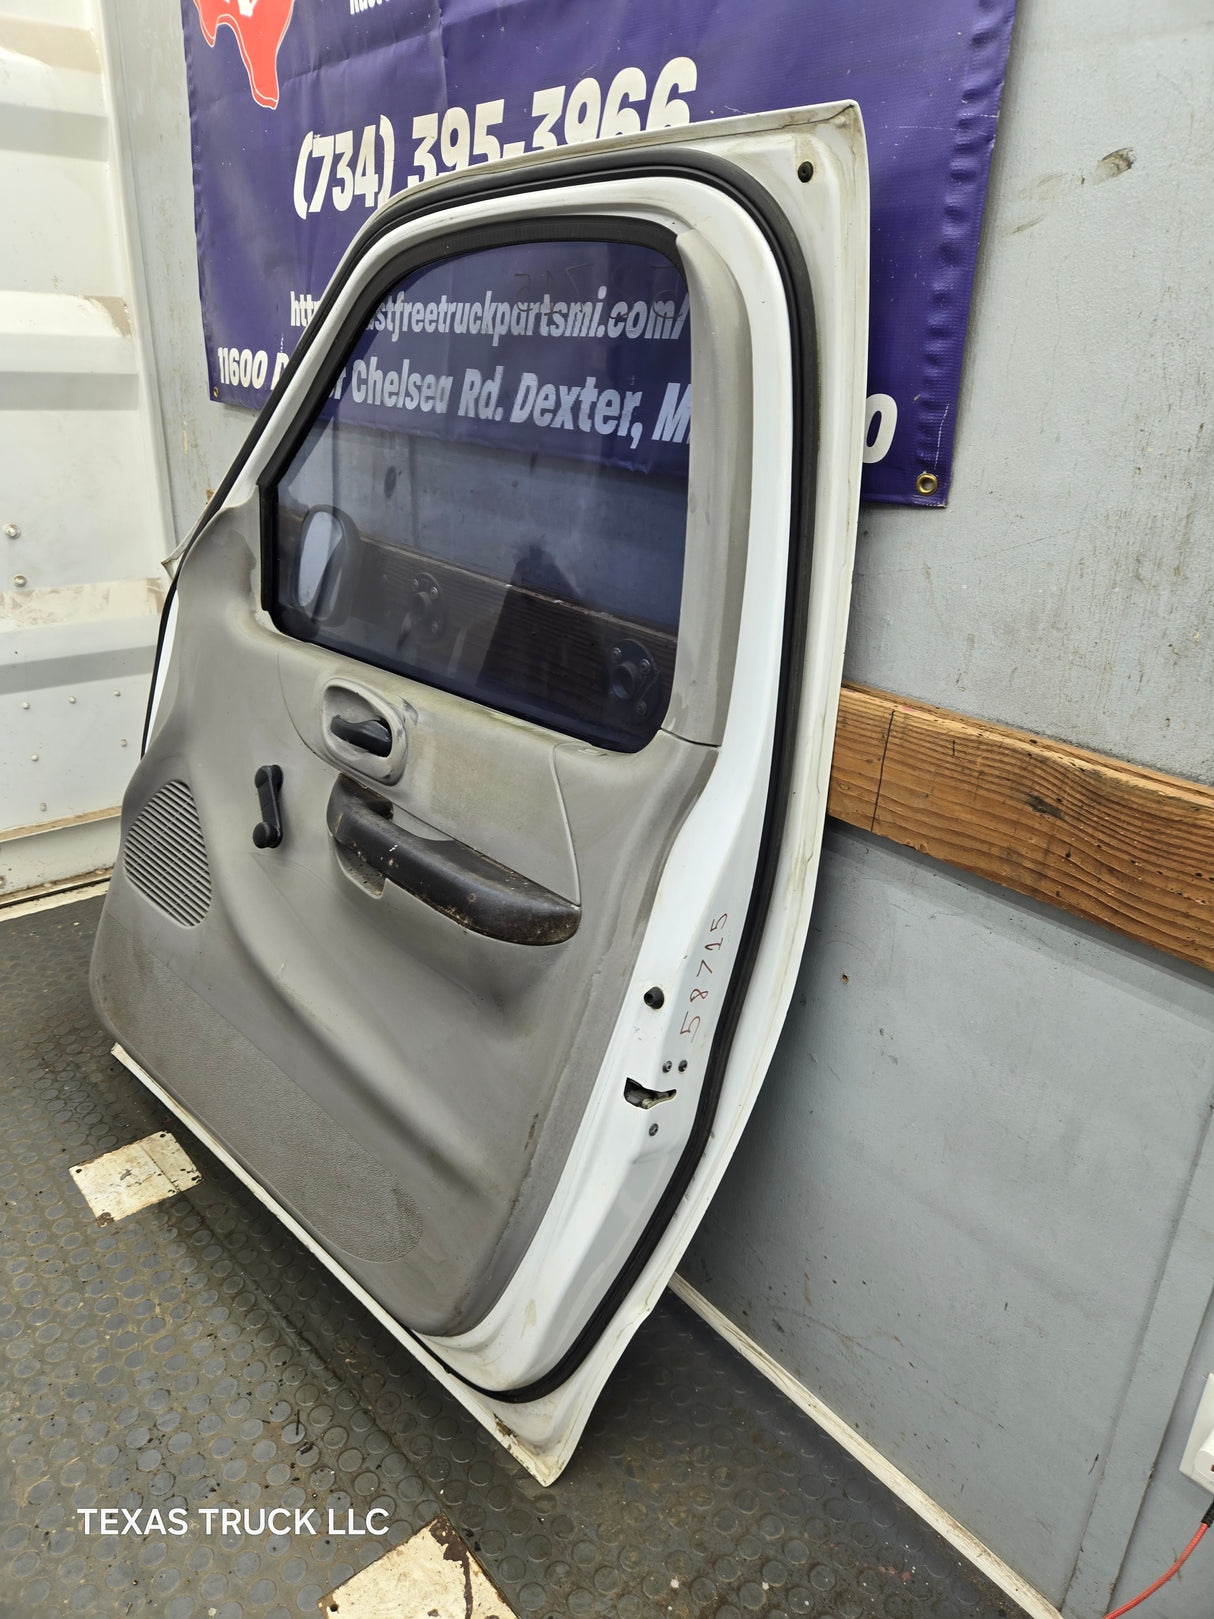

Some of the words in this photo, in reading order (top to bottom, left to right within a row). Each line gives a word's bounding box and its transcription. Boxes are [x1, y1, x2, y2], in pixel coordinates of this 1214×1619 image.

[293, 114, 395, 220] (734)
[407, 56, 698, 188] 395-3966
[218, 347, 268, 390] 11600
[351, 356, 454, 414] Chelsea
[457, 365, 505, 422] Rd.
[509, 372, 643, 450] Dexter,
[651, 382, 692, 445] M
[679, 912, 728, 1044] 58715
